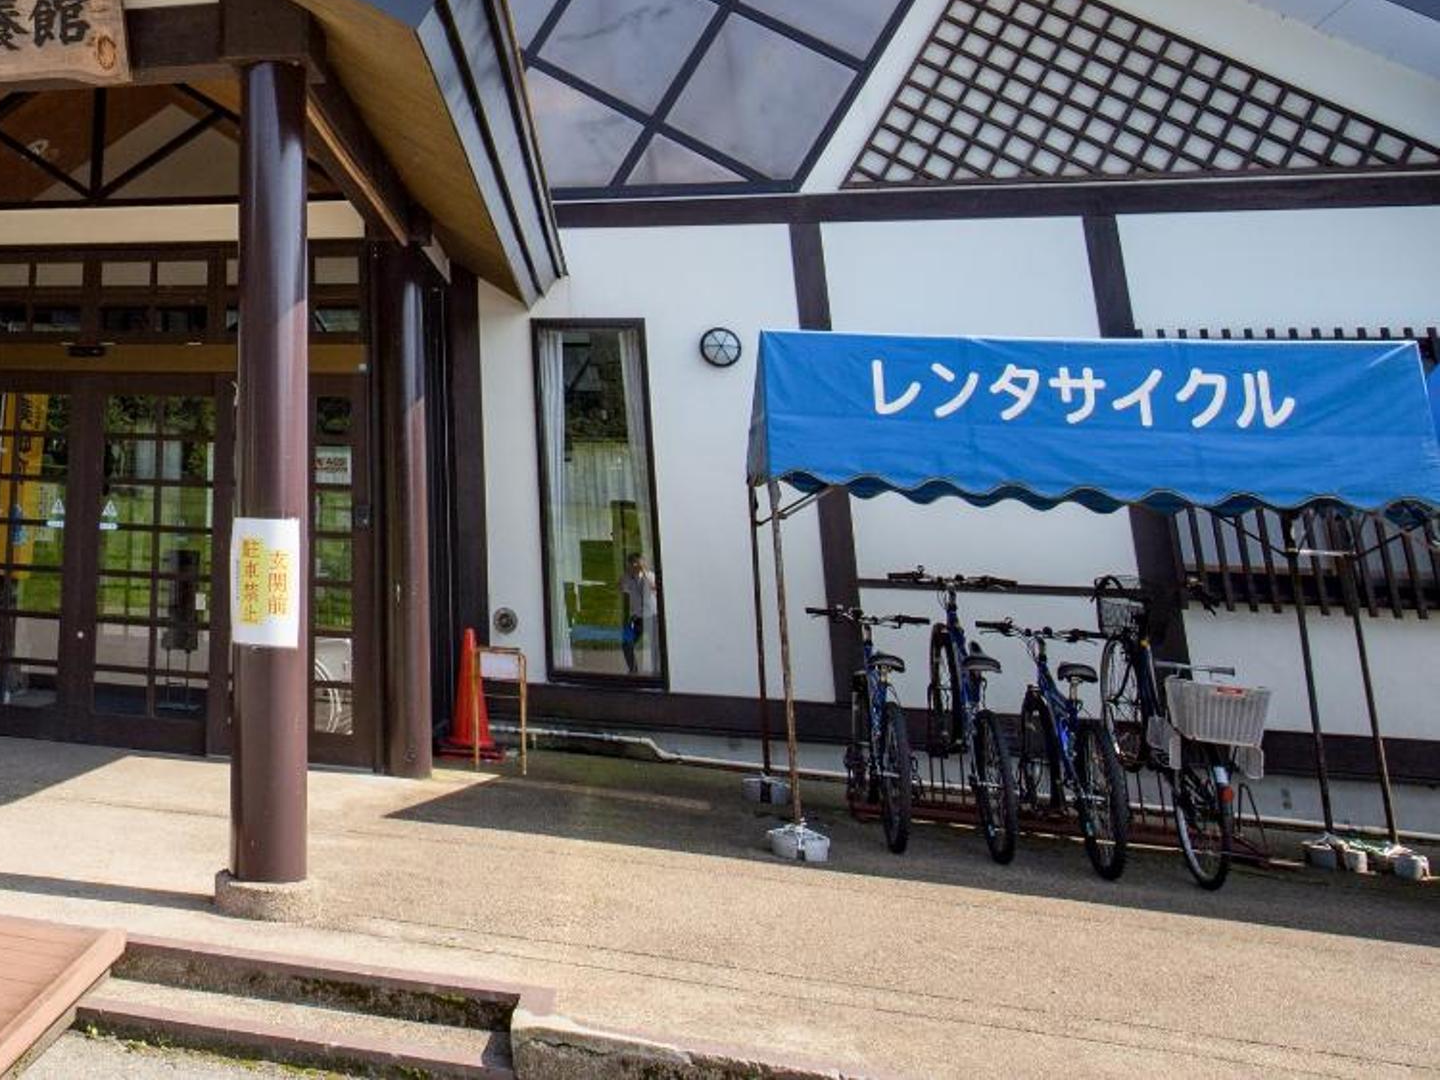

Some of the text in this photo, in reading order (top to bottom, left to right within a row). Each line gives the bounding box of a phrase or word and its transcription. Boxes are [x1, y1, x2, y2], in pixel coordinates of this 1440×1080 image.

[871, 358, 1296, 429] レンタサイクル
[267, 550, 289, 616] 玄関前
